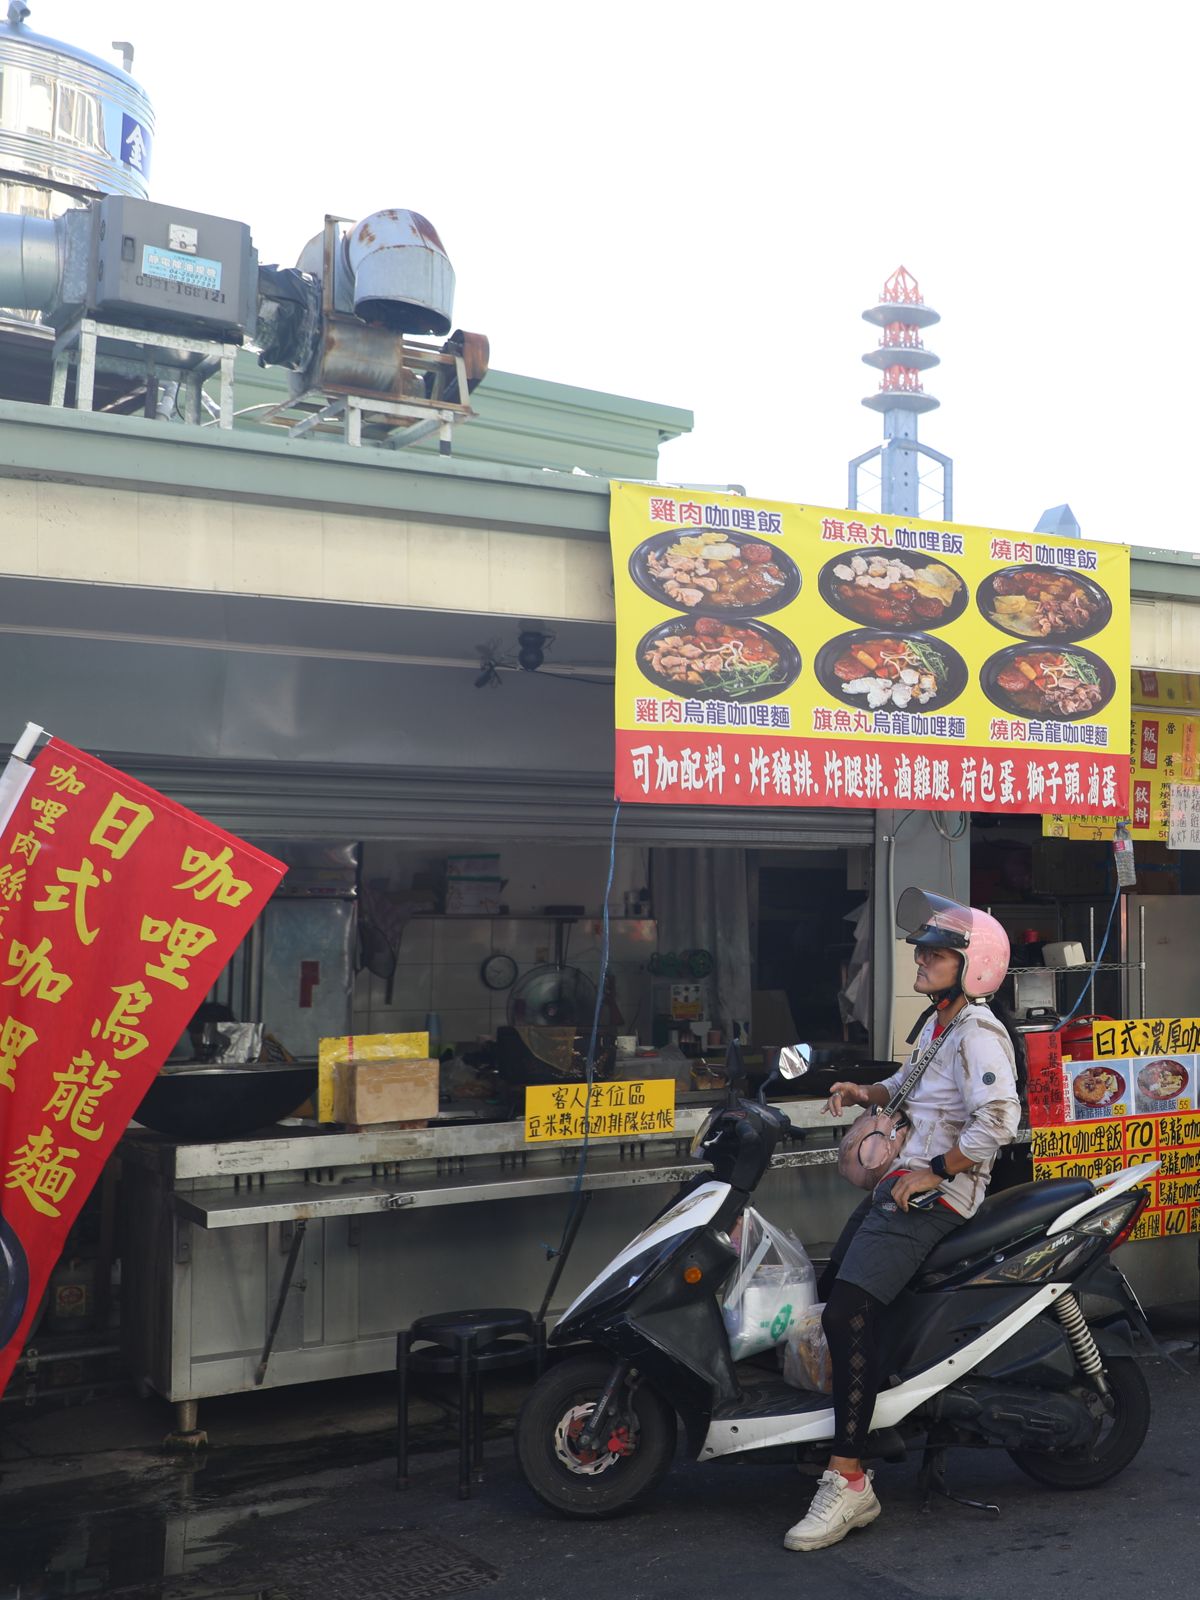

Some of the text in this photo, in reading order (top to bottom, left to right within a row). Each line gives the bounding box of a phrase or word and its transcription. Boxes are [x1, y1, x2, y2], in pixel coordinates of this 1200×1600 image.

[650, 498, 783, 534] 雞肉咖哩飯
[822, 518, 964, 556] 旗魚丸咖哩飯
[991, 538, 1098, 570] 燒肉咖哩飯
[636, 698, 791, 729] 雞肉烏龍咖哩麵
[813, 708, 966, 739] 旗魚丸烏龍咖哩麵
[990, 720, 1108, 747] 燒肉烏龍咖哩麵
[1143, 727, 1157, 765] 飯麵
[1163, 768, 1174, 776] 15
[1135, 786, 1149, 823] 飲料
[0, 765, 86, 939] 咖哩肉絲
[4, 846, 253, 1217] 咖哩烏龍麵
[551, 1083, 646, 1110] 客人座位區
[1033, 1124, 1122, 1157] 旗魚丸咖哩飯
[1126, 1121, 1153, 1148] 70
[1166, 1209, 1186, 1234] 40
